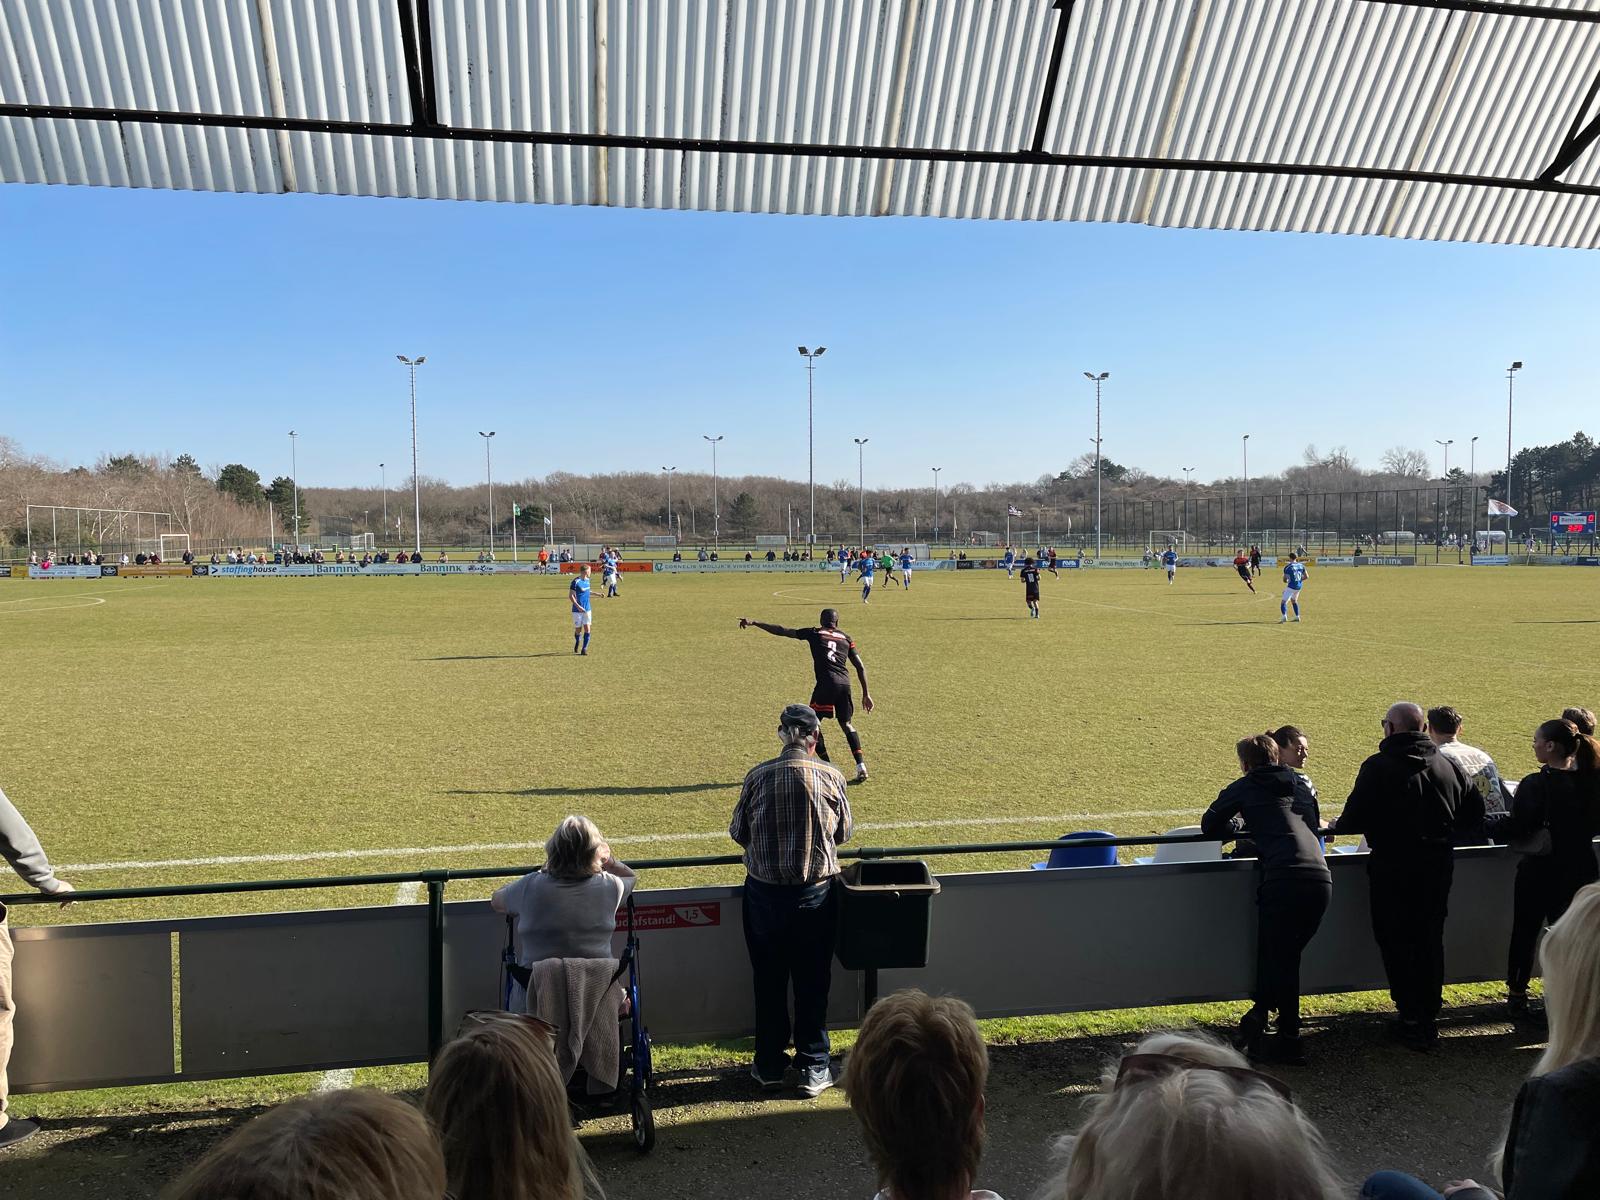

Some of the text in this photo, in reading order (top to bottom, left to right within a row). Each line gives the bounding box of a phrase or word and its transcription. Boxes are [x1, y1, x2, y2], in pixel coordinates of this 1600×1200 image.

[221, 565, 277, 574] staffinghouse
[316, 564, 360, 573] Bannink
[420, 564, 462, 572] Bannink
[827, 640, 837, 662] 2
[632, 913, 676, 927] afstand!
[685, 909, 699, 921] 1,5
